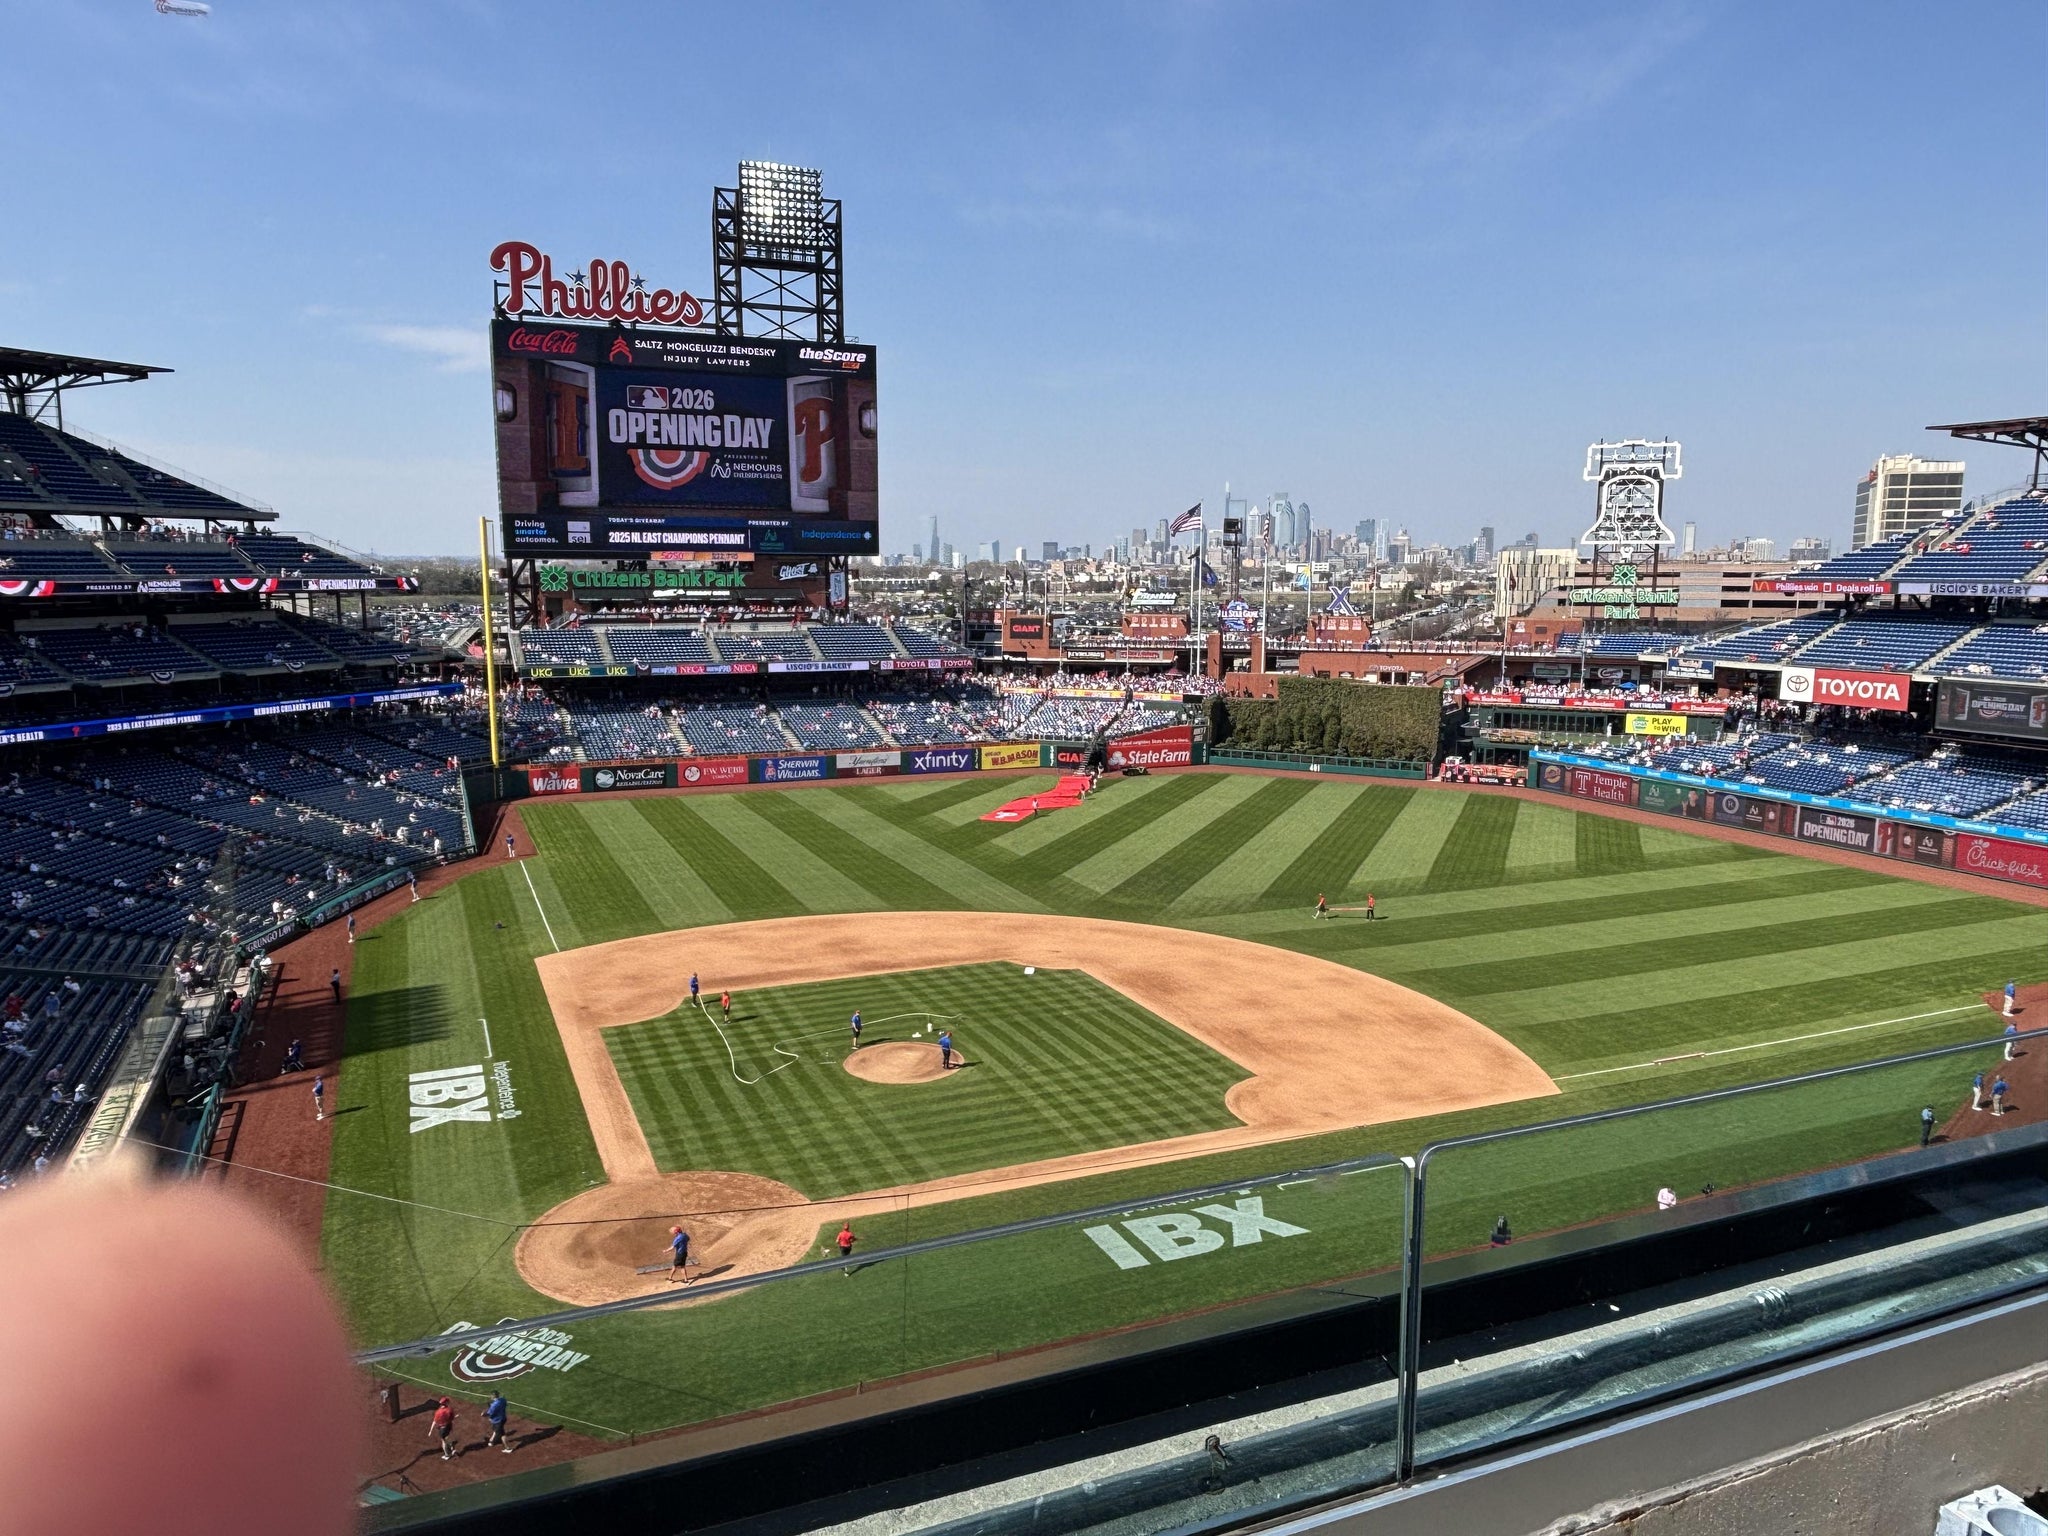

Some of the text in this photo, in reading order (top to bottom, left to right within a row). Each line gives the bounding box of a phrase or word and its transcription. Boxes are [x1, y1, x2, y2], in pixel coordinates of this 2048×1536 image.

[489, 241, 704, 326] Phillies
[634, 340, 776, 357] SALTZ MONGELUZZI BENDESKY
[798, 347, 867, 363] theScore
[663, 355, 700, 364] INJURY
[671, 387, 715, 411] 2026
[608, 408, 776, 449] OPENING DAY
[733, 462, 782, 472] NEMOURS
[514, 519, 545, 529] Driving
[608, 531, 631, 544] 2025
[642, 532, 662, 544] EAST
[662, 532, 709, 545] CHAMPIONS
[709, 533, 745, 545] PENNANT
[801, 529, 861, 540] Independence
[319, 579, 377, 590] OPENING DAY 2026
[572, 569, 746, 588] Citizens Bank Park
[1569, 589, 1679, 604] Citizens Bank
[1930, 584, 2031, 595] LISCIO'S BAKERY
[1604, 604, 1640, 619] Park
[1012, 624, 1041, 633] GIANT
[606, 666, 628, 675] UKG
[895, 660, 926, 669] TOYOTA
[943, 659, 973, 668] TOYOTA
[530, 668, 553, 677] UKG
[568, 667, 591, 676] UKG
[1818, 677, 1901, 702] TOYOTA
[1651, 717, 1673, 725] PLAY
[778, 759, 819, 769] SHERWIN
[914, 752, 968, 770] xfinity
[615, 769, 665, 781] NovaCare
[856, 767, 882, 775] LAGER
[532, 778, 580, 792] Wawa
[1592, 773, 1628, 789] Temple
[1593, 786, 1625, 802] Health
[1837, 817, 1855, 828] 2026
[1803, 821, 1871, 847] OPENING DAY
[408, 1064, 492, 1134] IBX
[1082, 1195, 1312, 1270] IBX
[528, 1328, 574, 1346] 2026
[529, 1344, 591, 1373] DAY
